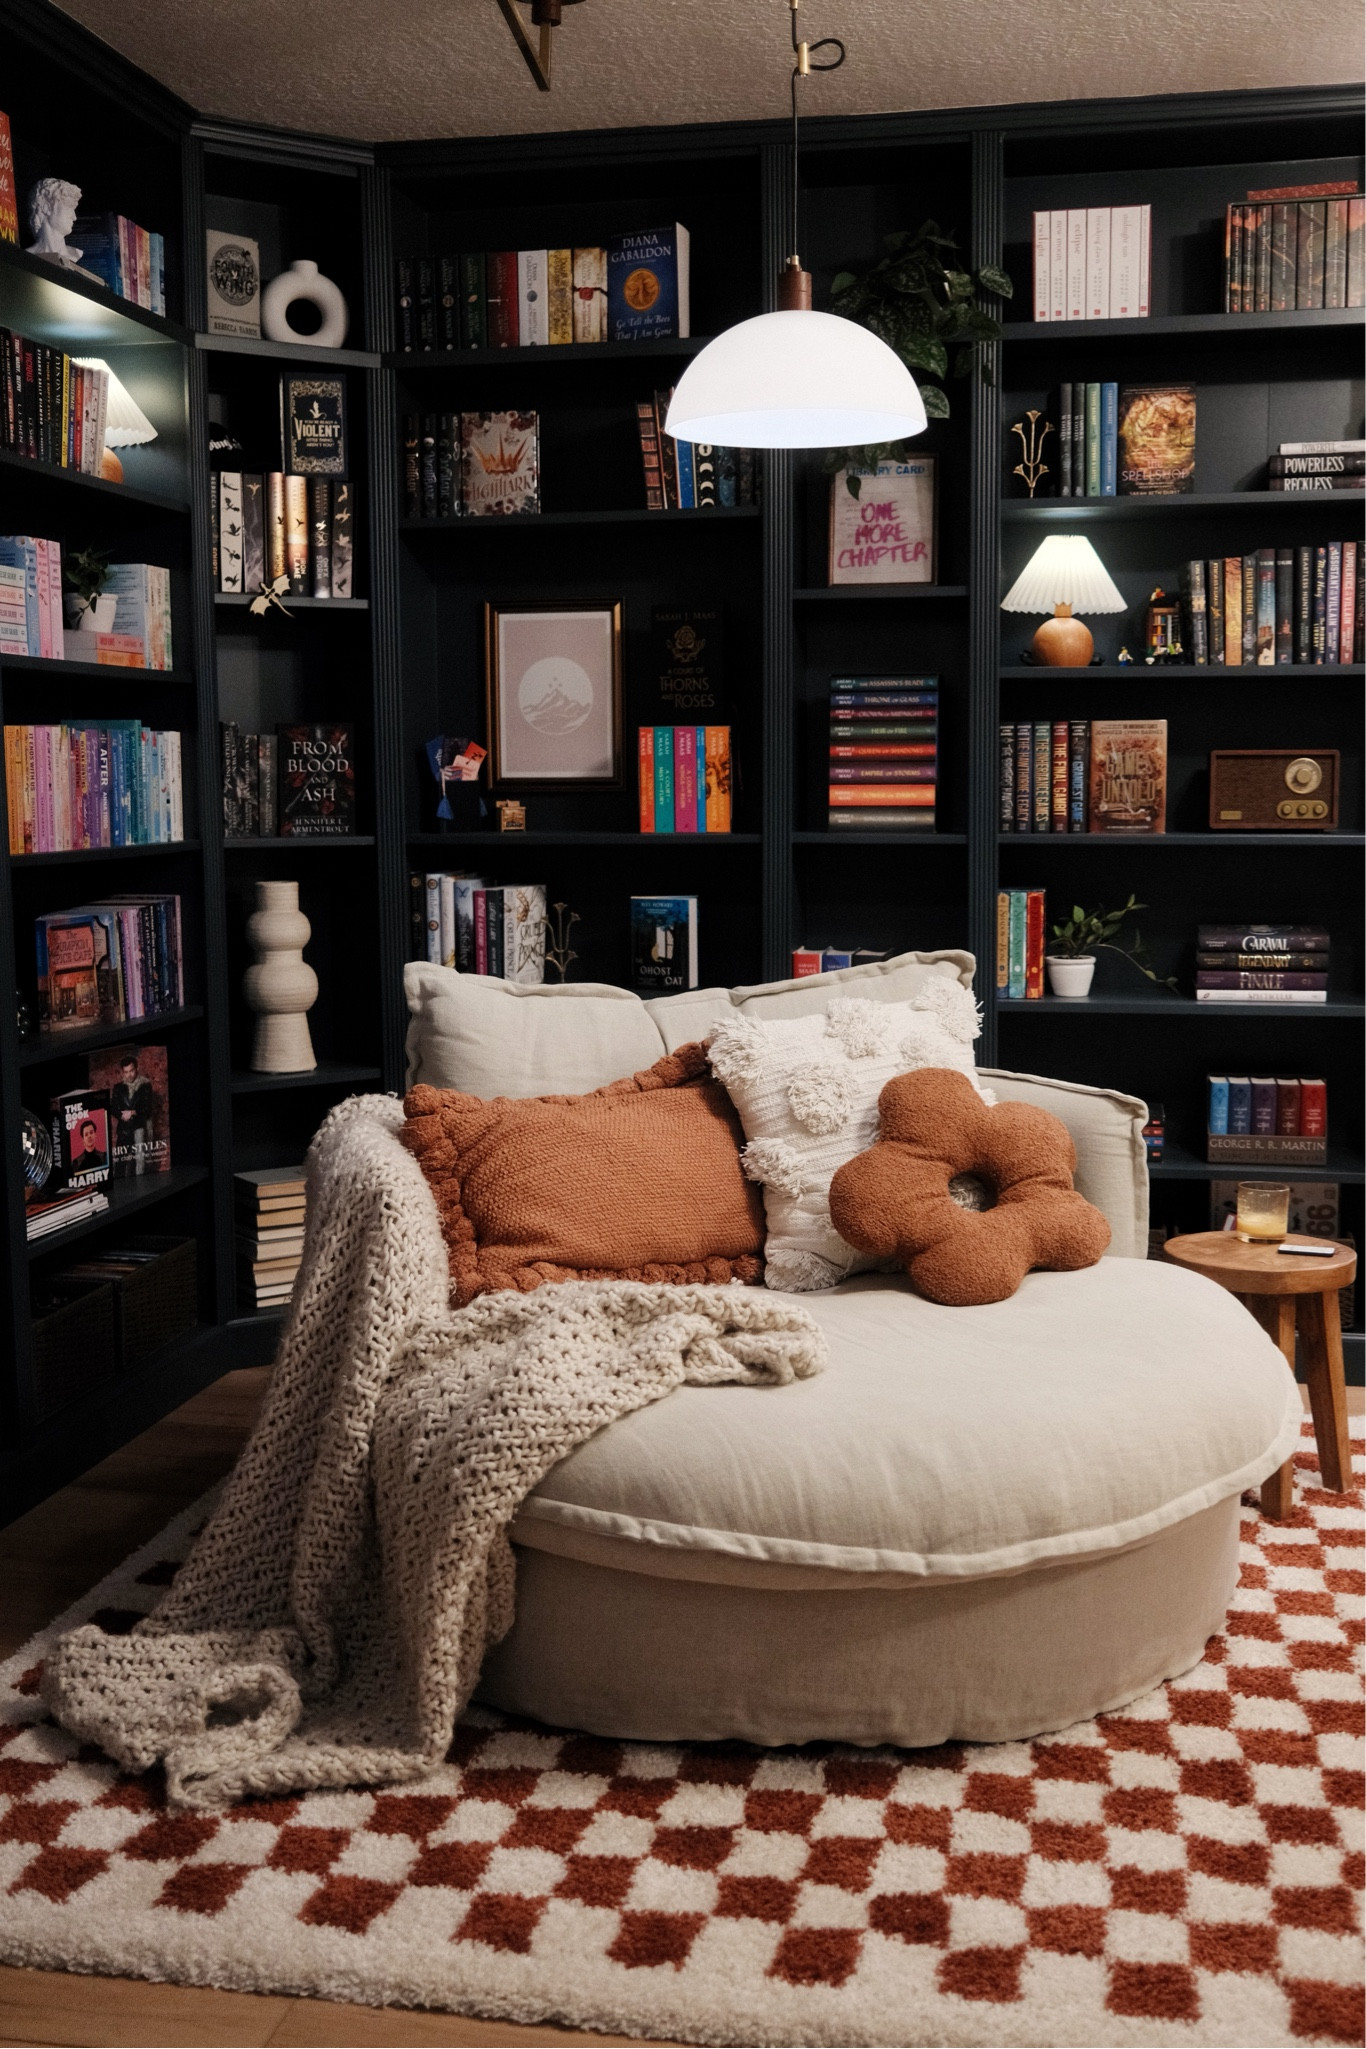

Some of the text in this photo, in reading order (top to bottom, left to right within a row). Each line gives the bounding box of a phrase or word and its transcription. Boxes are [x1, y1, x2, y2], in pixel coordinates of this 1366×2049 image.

[1093, 215, 1102, 244] breaking
[1121, 214, 1131, 243] midnight
[622, 234, 658, 249] DIANA
[1037, 224, 1048, 257] twilight
[1071, 224, 1082, 254] eclipse
[611, 246, 672, 264] GABALDON
[214, 322, 236, 332] REBECCA
[616, 315, 670, 330] Go Tell the Bees
[615, 328, 672, 341] That Am Gone
[294, 417, 340, 440] VIOLENT
[896, 465, 925, 475] CARD
[1284, 456, 1344, 474] POWERLESS
[1122, 469, 1188, 482] SPELLSHOP
[1284, 476, 1333, 491] RECKLESS
[472, 475, 531, 501] LIGHTLARK
[861, 501, 900, 523] ONE
[855, 522, 908, 545] MORE
[838, 542, 928, 569] CHAPTER
[1313, 559, 1326, 598] Matt Haig
[1329, 551, 1339, 626] ASSISTANT VILLAIN
[1344, 552, 1353, 624] APPRENTICE VILLAIN
[655, 612, 682, 621] SARAH
[692, 611, 720, 620] MAAS
[659, 676, 710, 691] THORNS
[673, 694, 715, 709] ROSES
[292, 741, 342, 755] FROM
[100, 748, 108, 786] AFTER
[288, 759, 349, 772] BLOOD
[1106, 751, 1153, 775] GAMES
[30, 782, 35, 791] US
[1017, 737, 1030, 822] THE HAWTHORNE LEGACY
[1036, 738, 1049, 822] THE INHERITANCE GAMES
[1053, 742, 1067, 816] THE FINAL GAMBIT
[301, 788, 335, 802] ASH
[1072, 761, 1084, 822] GRANDEST GAME
[1103, 779, 1155, 802] UNTOLD
[520, 922, 545, 940] CRUEL
[56, 939, 88, 952] PUMPKIN
[1242, 935, 1290, 952] CARAVAL
[1238, 954, 1292, 968] LEGENDARY
[640, 966, 672, 976] GHOST
[665, 977, 683, 986] CAT
[1240, 972, 1284, 989] FINALE
[64, 1102, 83, 1114] THE
[65, 1110, 89, 1123] BOOK
[65, 1120, 77, 1131] OF
[52, 1126, 62, 1169] HARRY
[131, 1139, 168, 1153] STYLES
[1209, 1139, 1325, 1150] GEORGE R. R. MARTIN
[68, 1169, 110, 1189] HARRY
